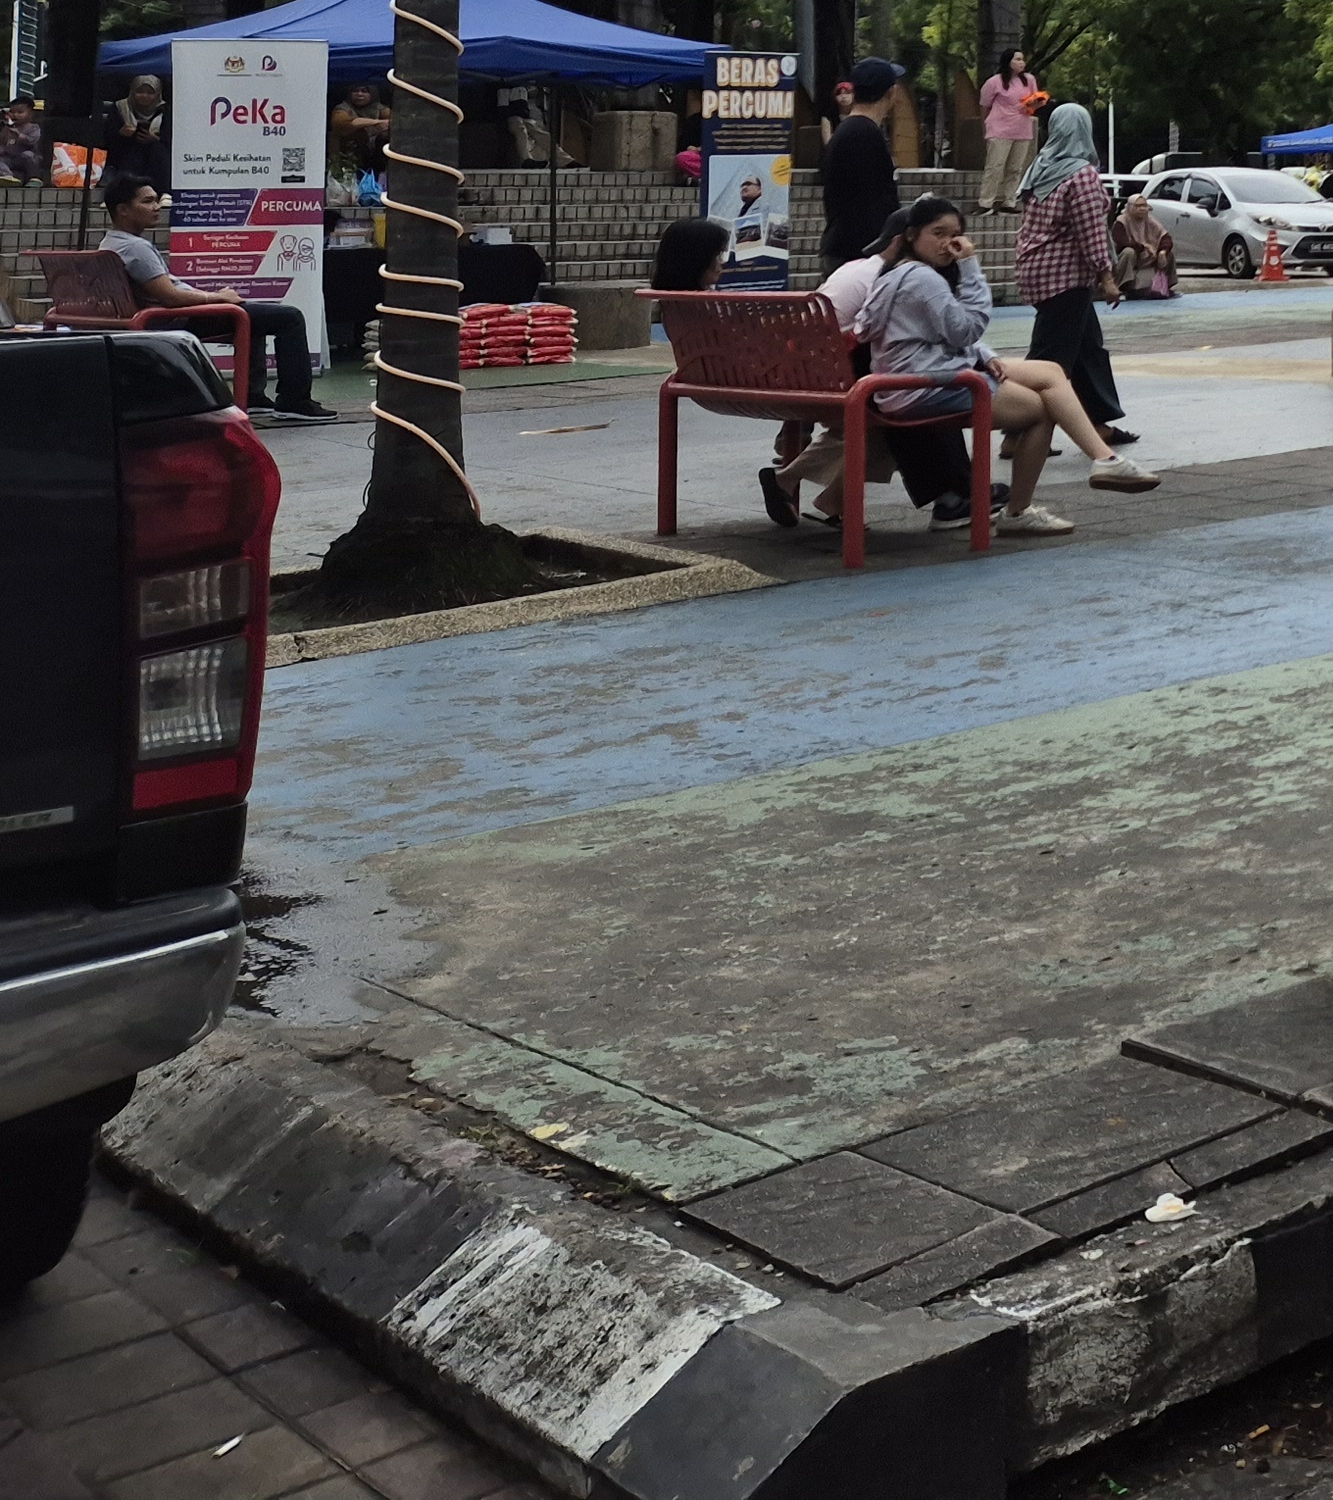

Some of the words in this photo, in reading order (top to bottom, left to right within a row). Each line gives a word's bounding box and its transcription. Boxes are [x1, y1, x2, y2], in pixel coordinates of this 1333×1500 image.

[716, 56, 780, 88] BERAS
[702, 89, 795, 119] PERCUMA
[210, 96, 286, 127] PeKa
[262, 126, 286, 137] B40
[183, 154, 203, 163] Skim
[206, 154, 230, 163] Peduli
[183, 167, 206, 175] untuk
[209, 167, 249, 177] Kumpulan
[251, 166, 270, 175] B40
[261, 200, 322, 212] PERCUMA
[187, 237, 194, 248] 1
[186, 261, 193, 272] 2
